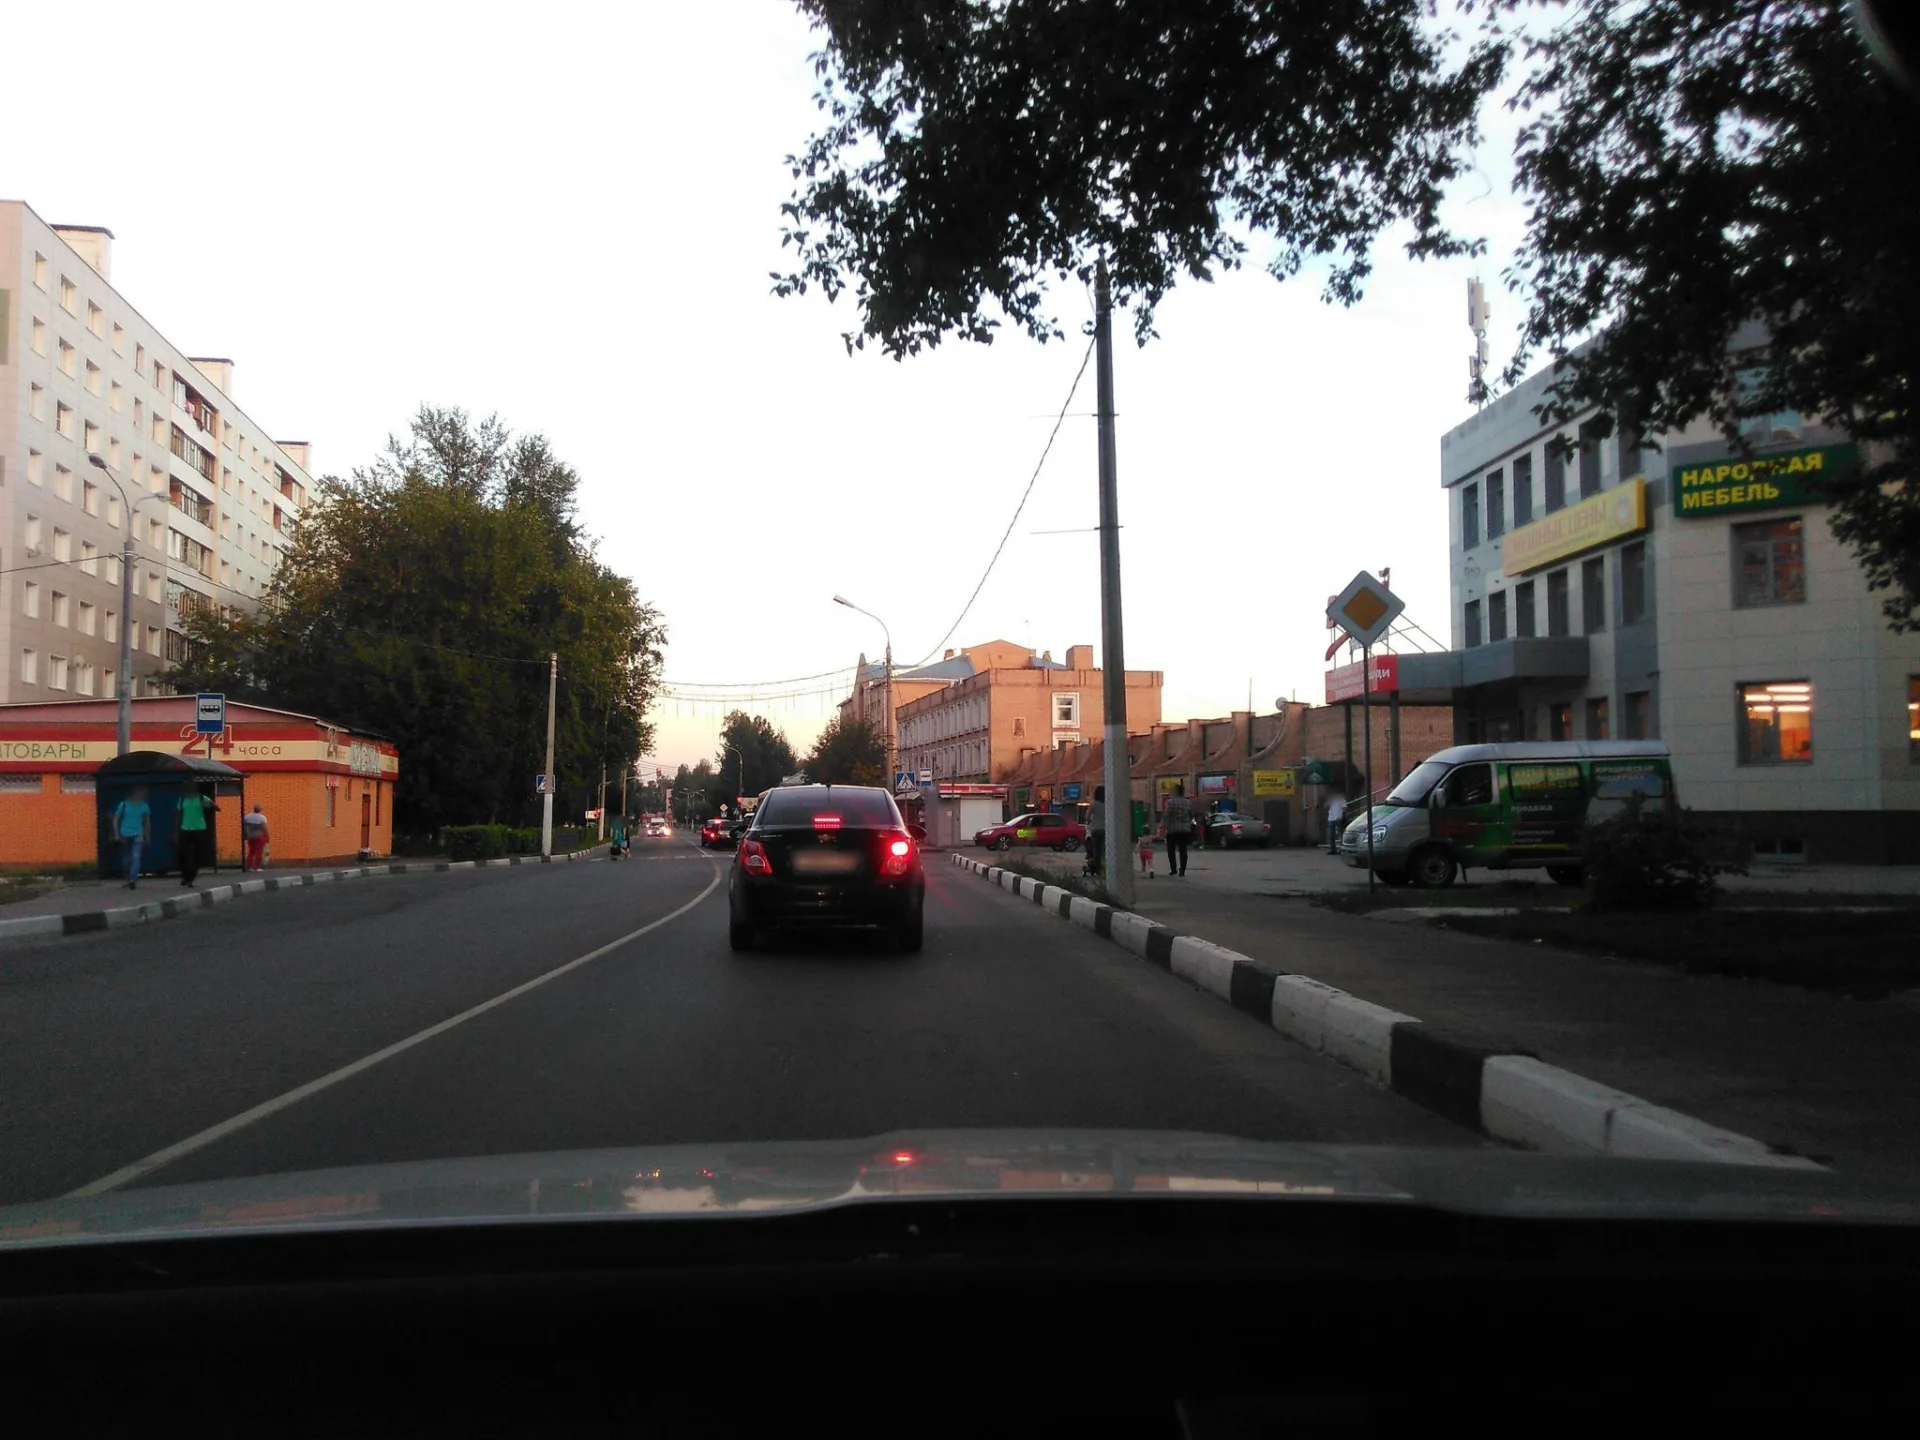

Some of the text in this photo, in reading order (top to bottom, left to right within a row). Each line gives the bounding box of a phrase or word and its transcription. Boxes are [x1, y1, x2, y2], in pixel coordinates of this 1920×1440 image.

[1682, 482, 1779, 509] МЕБЕЛЬ
[180, 723, 281, 756] 24 часа
[0, 743, 86, 759] ТОВАРЫ
[1511, 804, 1553, 814] продажа
